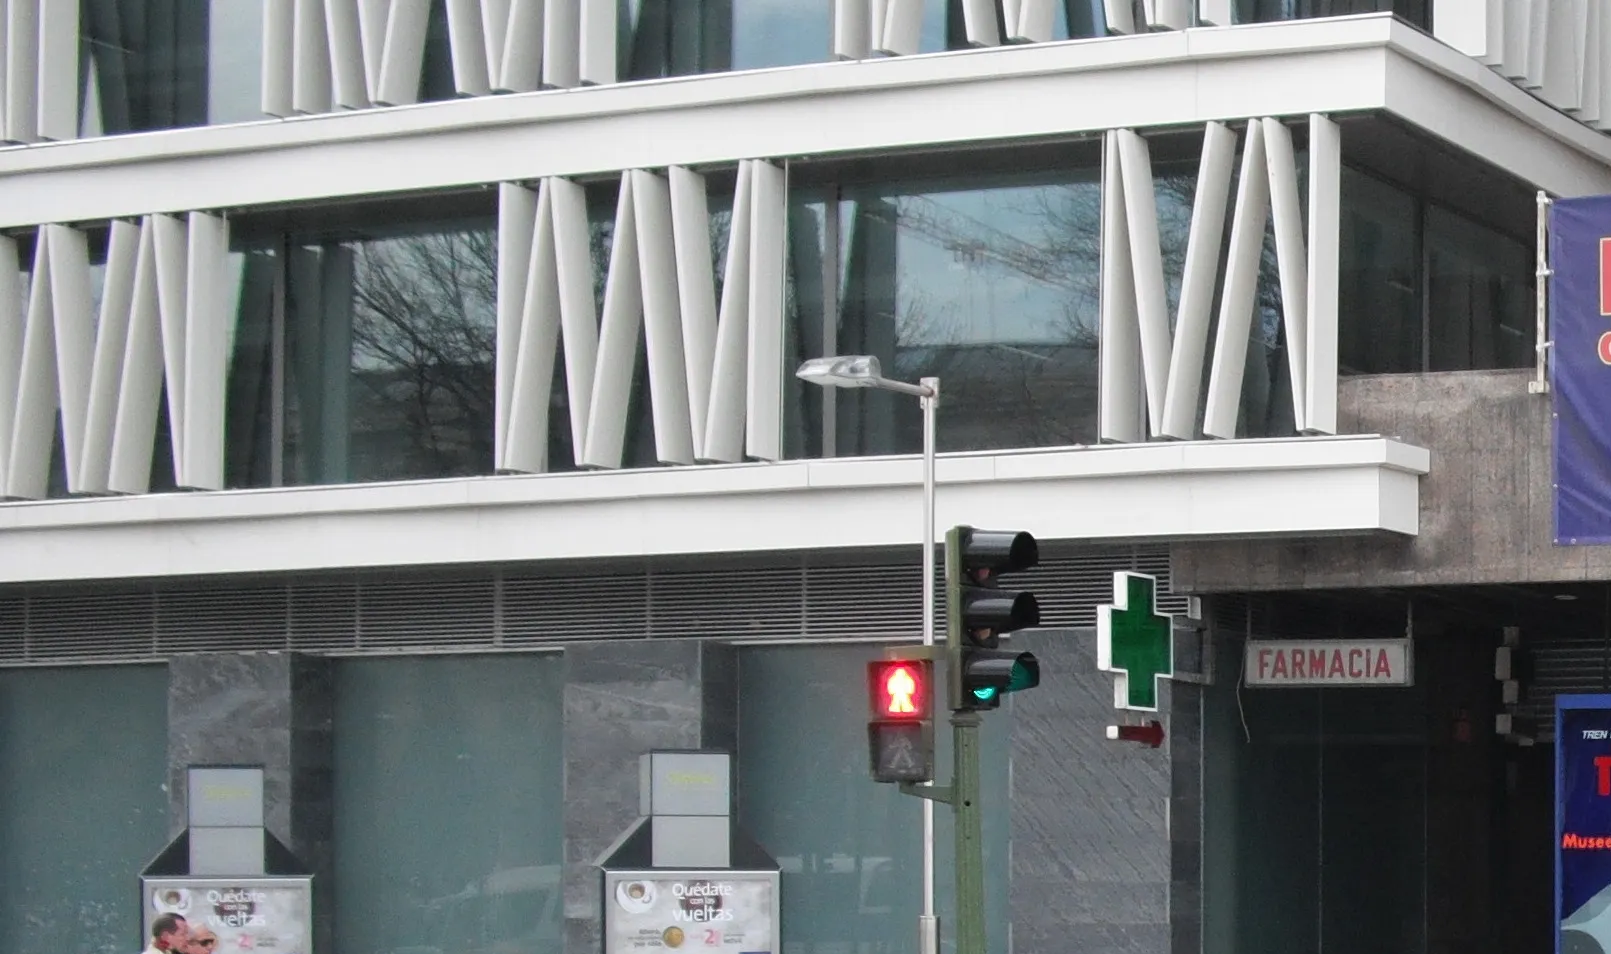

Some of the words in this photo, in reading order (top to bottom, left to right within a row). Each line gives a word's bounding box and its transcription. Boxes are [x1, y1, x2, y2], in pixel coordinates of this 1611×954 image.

[1258, 648, 1391, 679] FARMACIA
[1582, 729, 1608, 740] TREN
[207, 889, 267, 906] Quédate
[672, 882, 734, 900] Quédate
[207, 911, 267, 928] vueltas
[672, 904, 734, 922] vueltas
